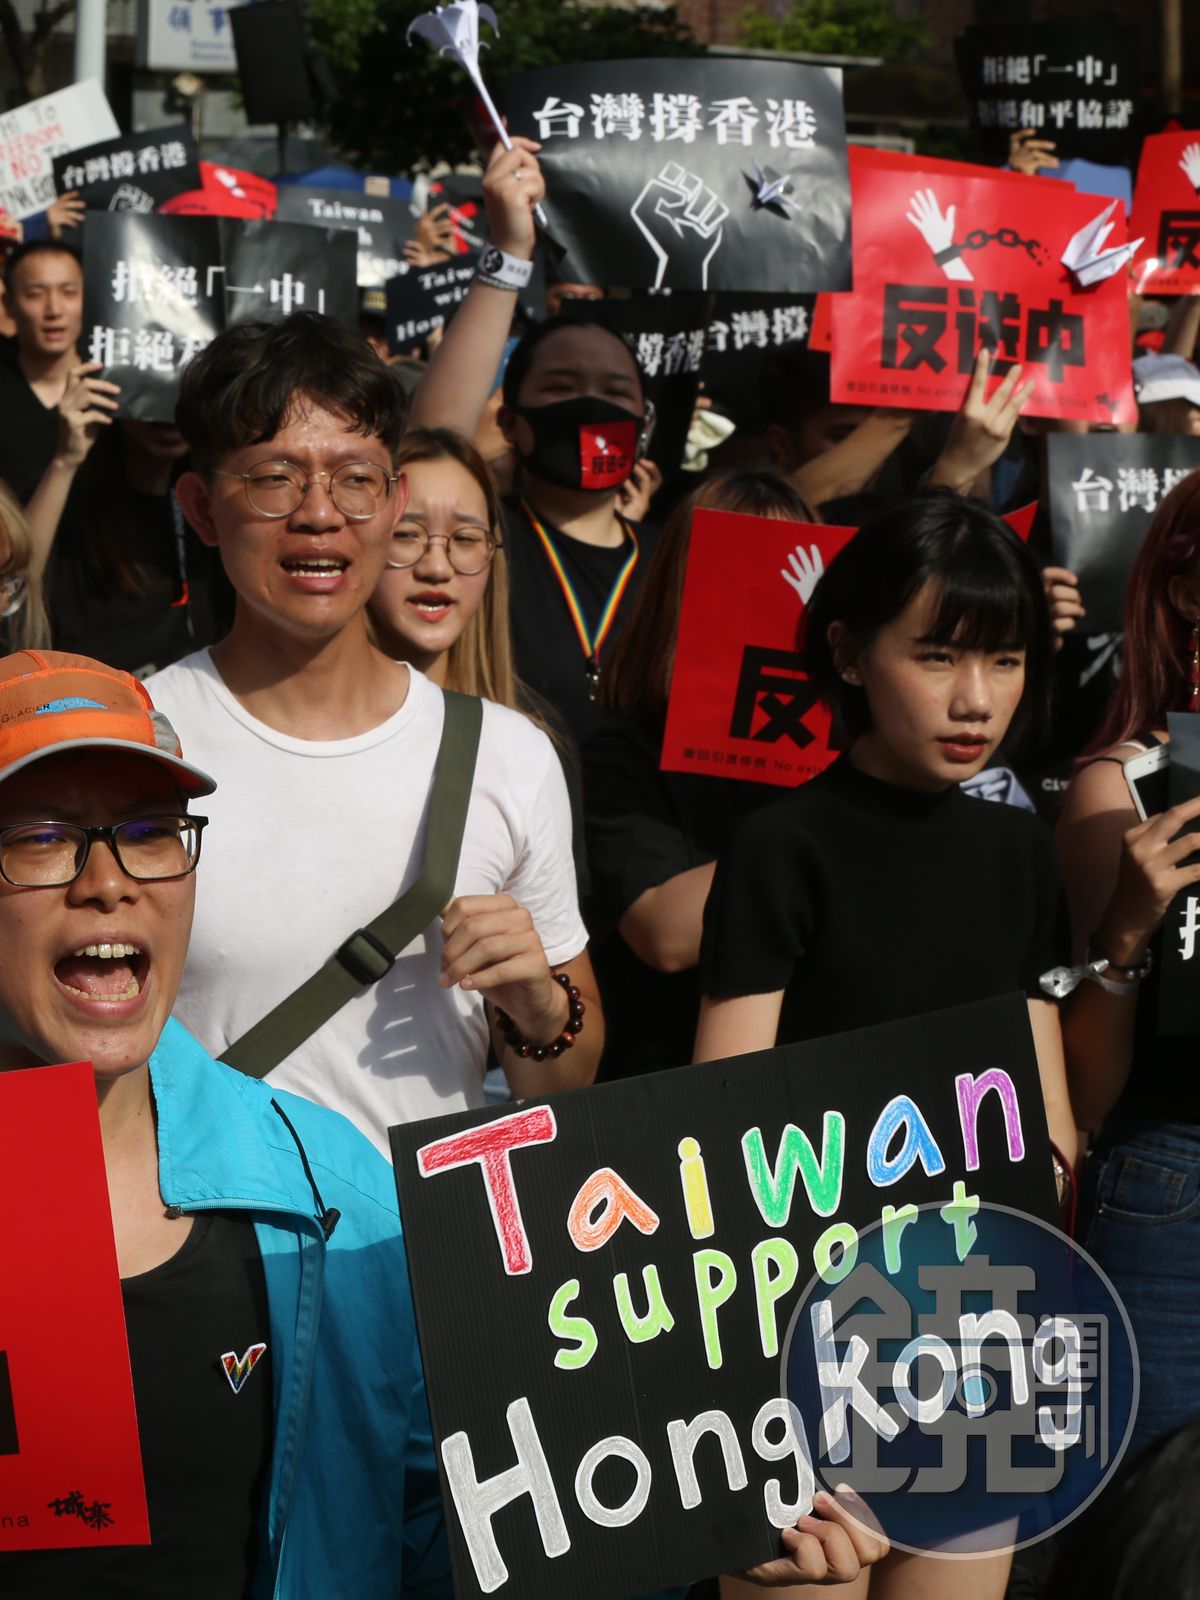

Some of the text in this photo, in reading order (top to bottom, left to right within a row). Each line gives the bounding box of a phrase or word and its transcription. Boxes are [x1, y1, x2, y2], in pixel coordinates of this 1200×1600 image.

[533, 93, 818, 148] 台灣撐香港
[307, 198, 384, 223] Taiwan
[880, 283, 1086, 383] 反送中
[417, 1067, 1026, 1275] Taiwan
[547, 1181, 981, 1370] support
[47, 1490, 115, 1531] 城寨
[440, 1396, 816, 1593] Hong
